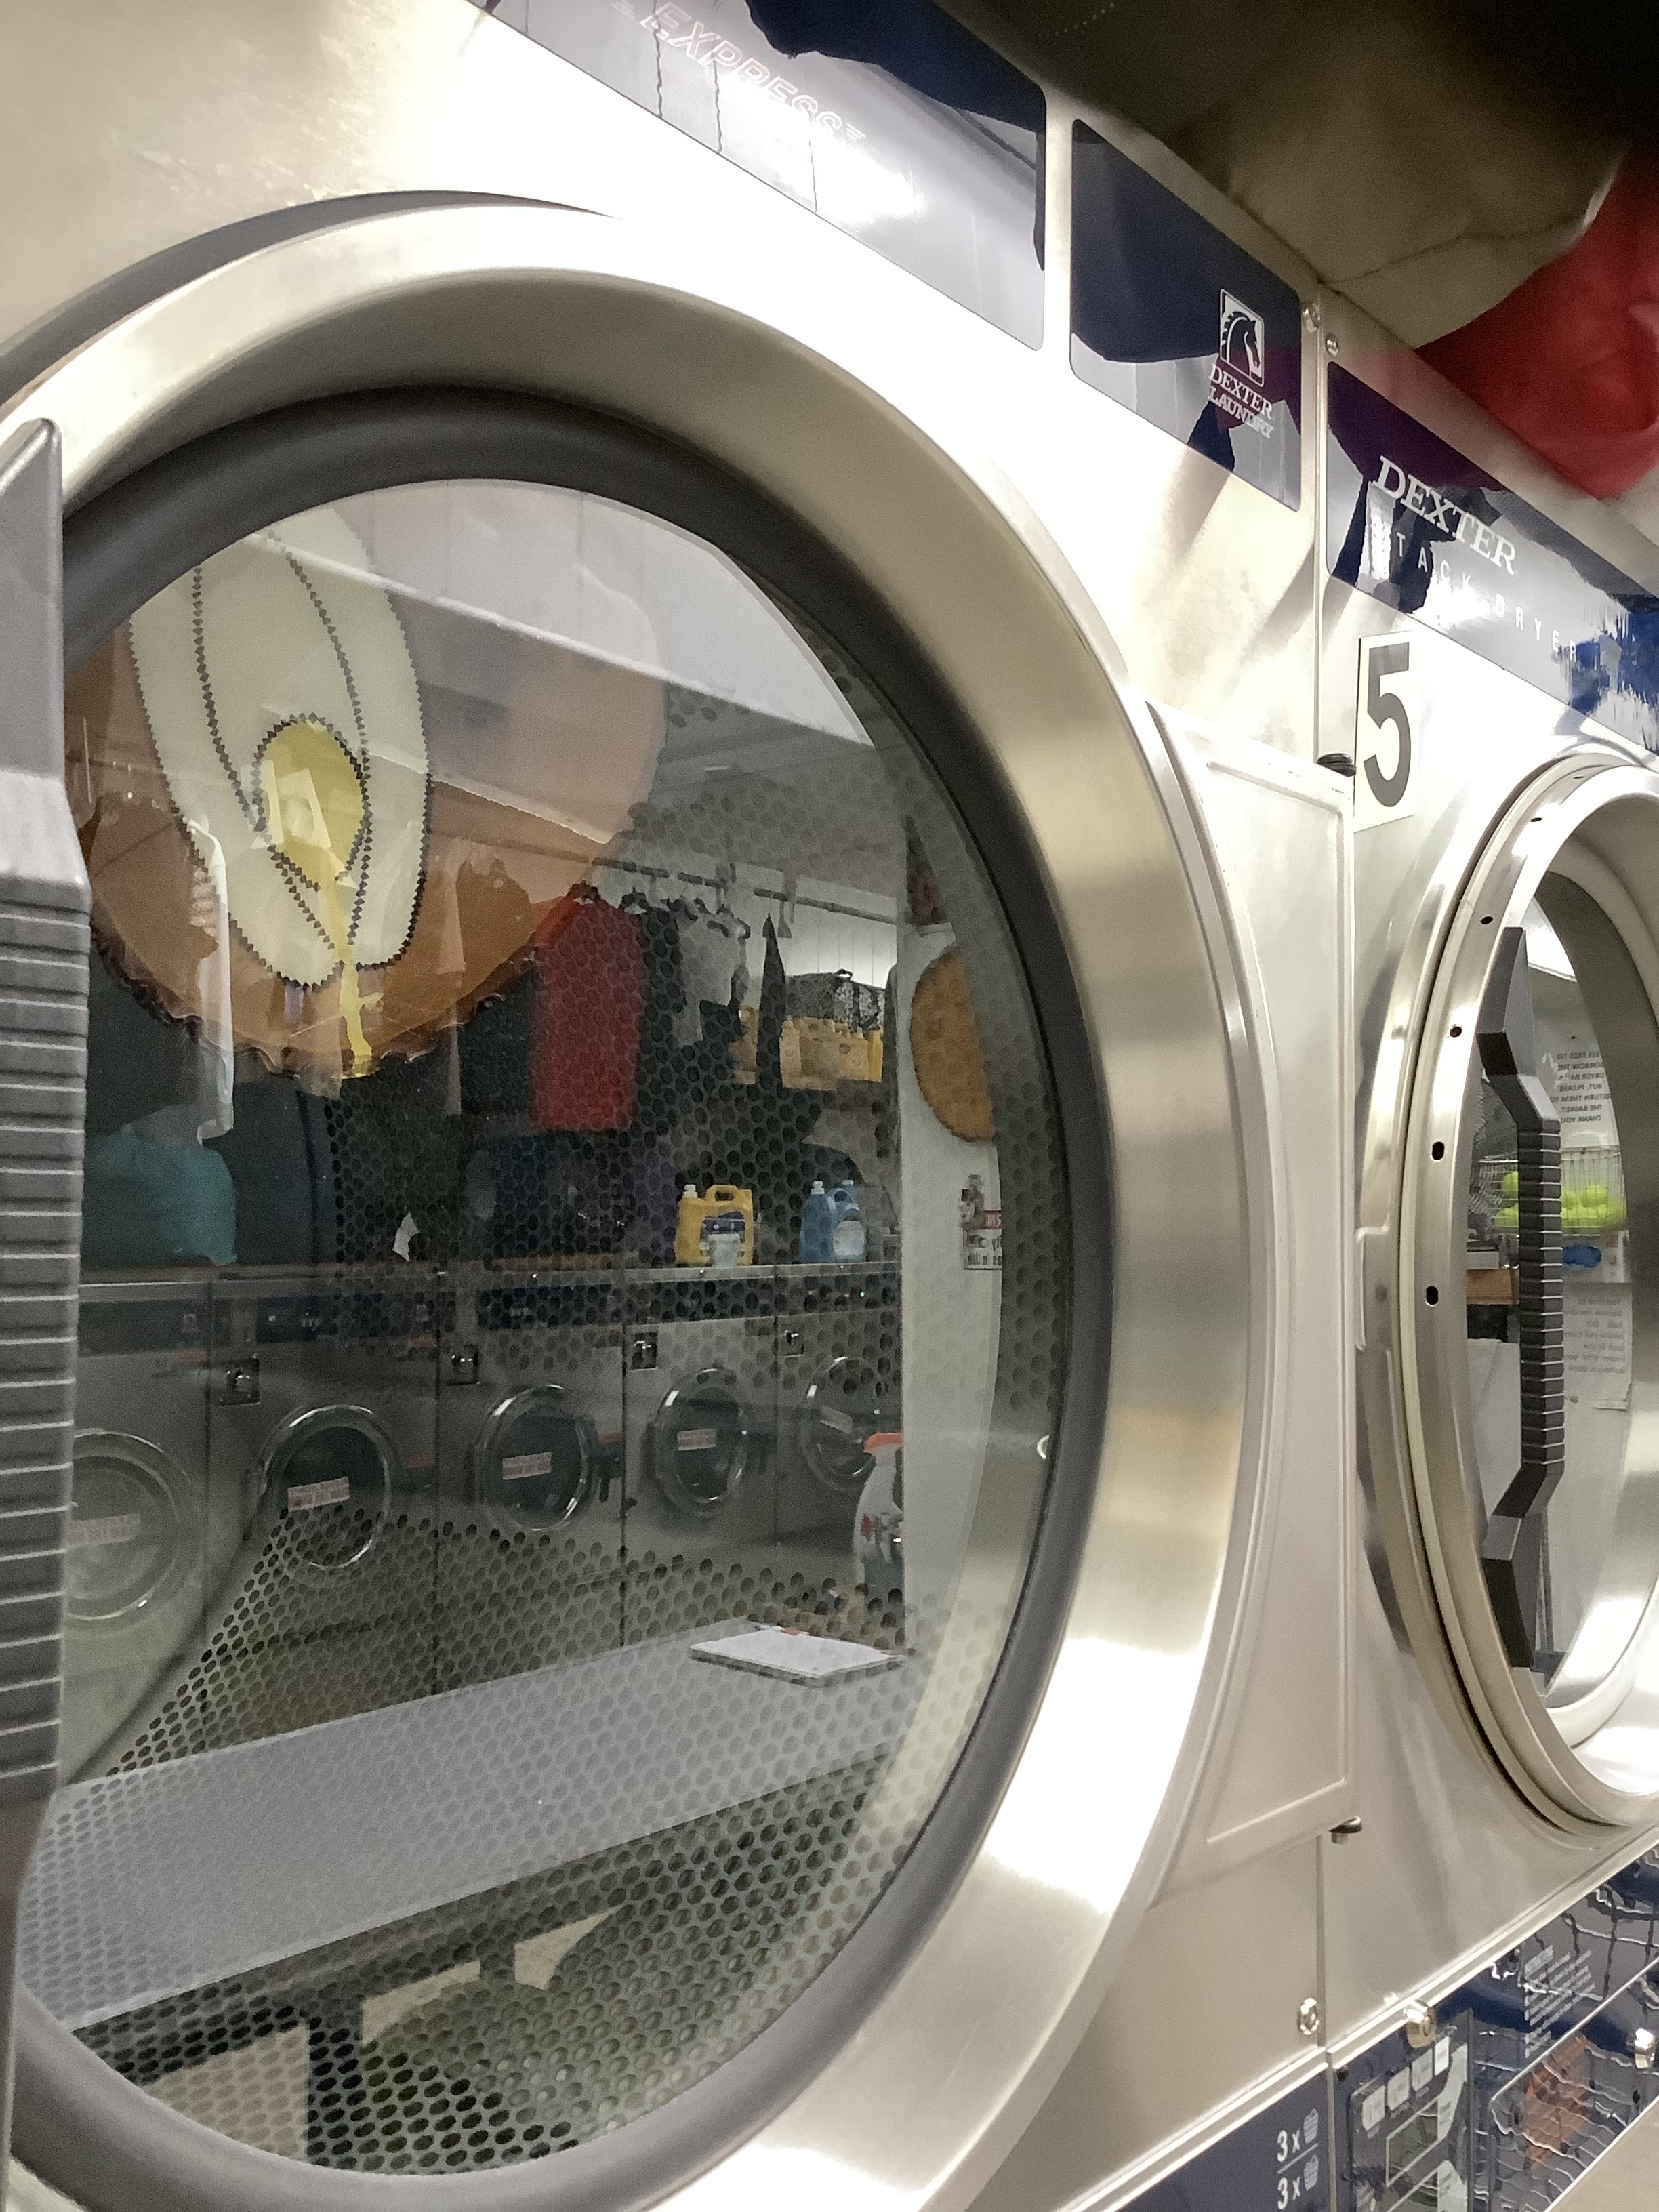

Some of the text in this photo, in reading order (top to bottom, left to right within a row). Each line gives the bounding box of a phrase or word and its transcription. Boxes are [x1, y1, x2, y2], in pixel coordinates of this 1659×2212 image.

[640, 2, 842, 139] EXPRESS
[1208, 363, 1272, 419] DEXTER
[1208, 386, 1275, 439] LAUNDRY
[1373, 456, 1517, 575] DEXTER
[1396, 532, 1577, 662] TACK DRYER
[1363, 642, 1411, 807] 5
[1277, 2129, 1300, 2162] 3 x
[1277, 2176, 1301, 2210] 3 x
